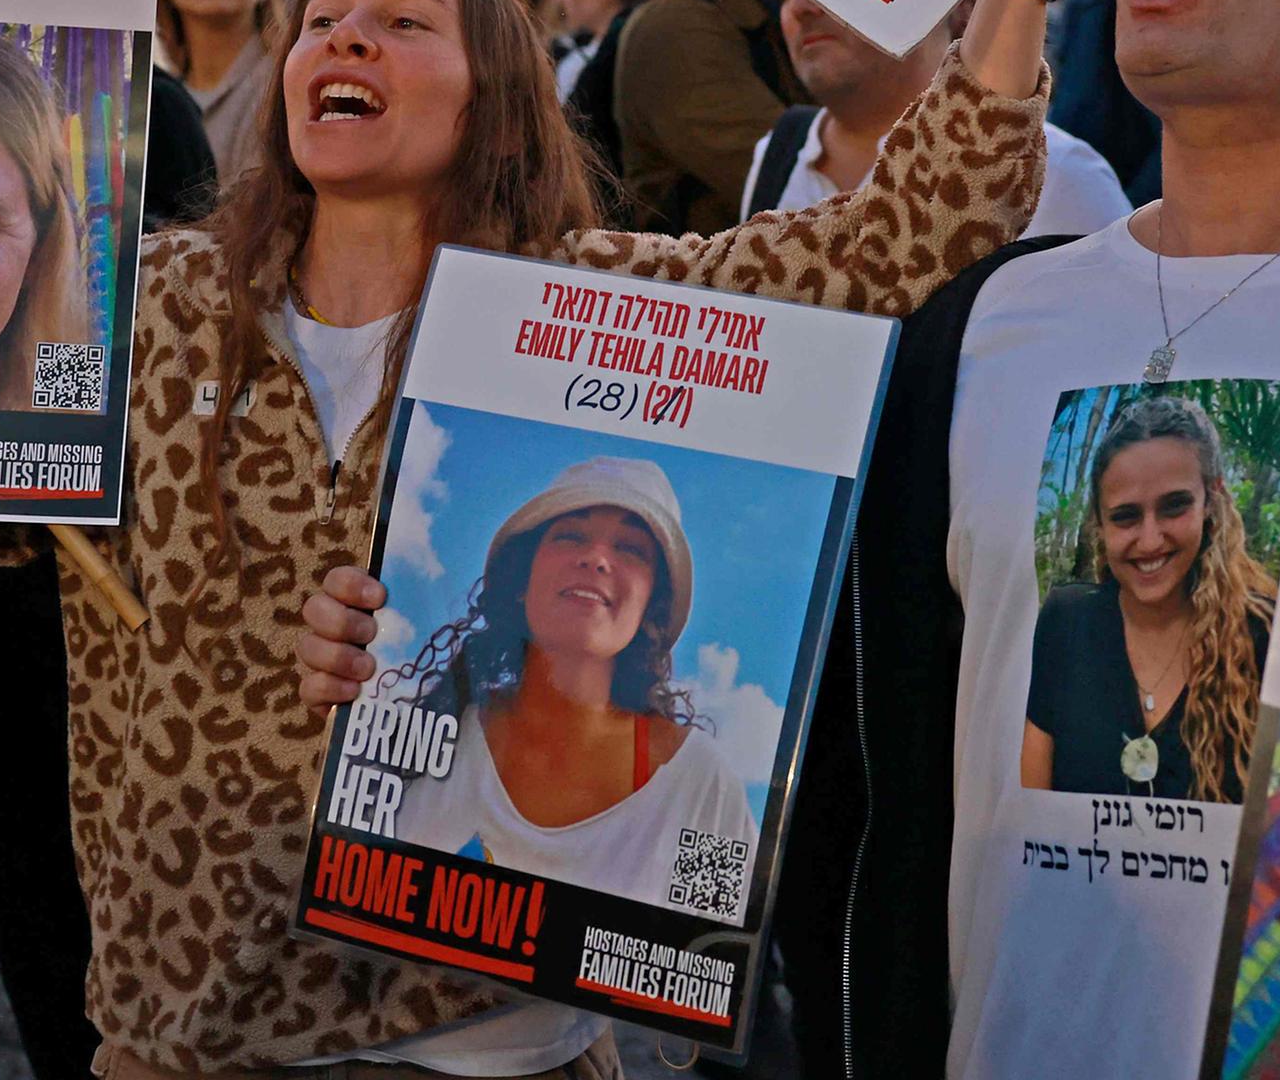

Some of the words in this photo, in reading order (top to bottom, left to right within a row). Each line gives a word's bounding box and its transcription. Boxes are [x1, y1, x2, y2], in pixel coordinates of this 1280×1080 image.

[542, 282, 612, 325] דמארי
[614, 294, 691, 339] תהילה
[698, 307, 765, 351] אמילי
[514, 320, 581, 363] EMILY
[586, 330, 664, 379] TEHILA
[668, 344, 769, 395] DAMARI
[565, 374, 638, 421] (28)
[20, 443, 45, 462] AND
[48, 444, 103, 464] MISSING
[37, 463, 101, 492] FORUM
[345, 699, 459, 779] BRING
[327, 758, 403, 839] HER
[1092, 798, 1133, 835] גונן
[1146, 802, 1204, 832] רומי
[1023, 840, 1069, 870] בבית
[1078, 839, 1110, 883] לך
[1121, 851, 1208, 884] מחכים
[314, 835, 423, 924] HOME
[426, 865, 545, 957] NOW!
[584, 926, 649, 962] HOSTAGES
[649, 944, 676, 969] AND
[677, 950, 735, 984] MISSING
[579, 948, 662, 999] FAMILIES
[663, 971, 732, 1018] FORUM
